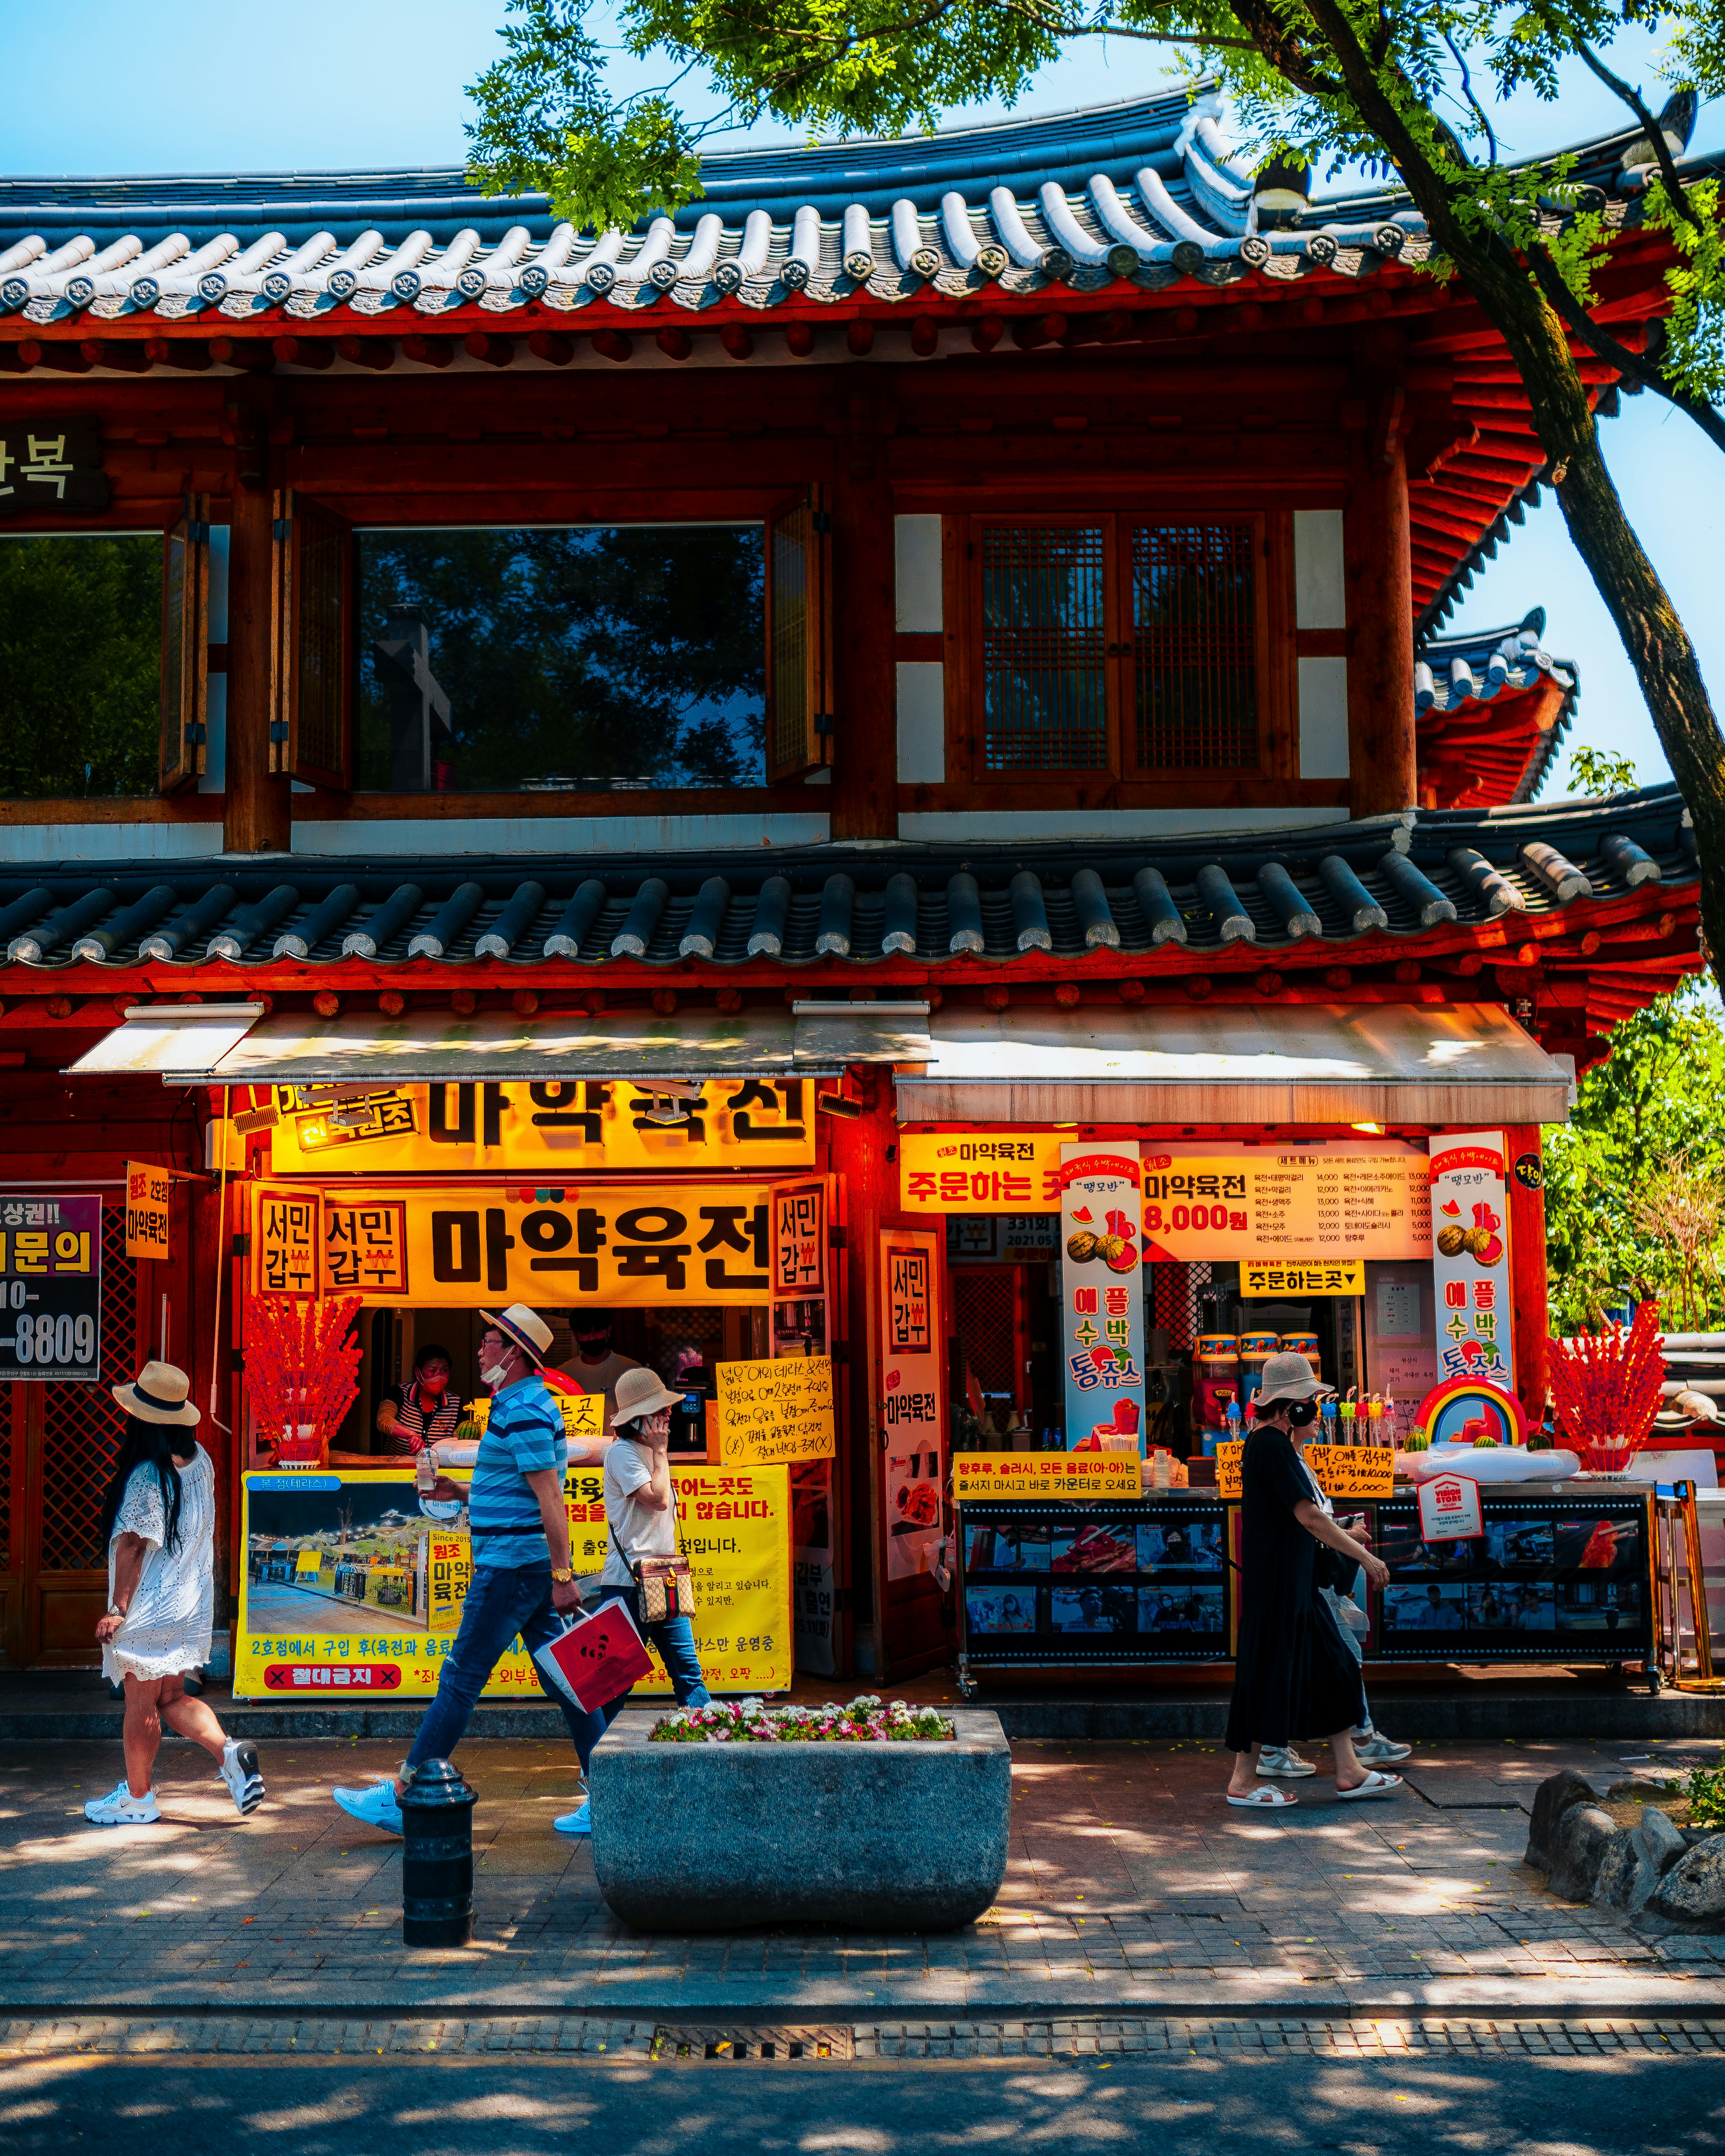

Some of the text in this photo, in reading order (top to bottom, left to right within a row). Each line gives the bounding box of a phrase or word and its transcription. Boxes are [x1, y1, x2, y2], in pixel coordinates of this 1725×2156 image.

[938, 1142, 1034, 1161] 원조 마약육전
[1065, 1159, 1135, 1175] 태국식 수박에이드
[1146, 1156, 1170, 1171] 원조
[130, 1173, 167, 1203] 원조 2호점
[908, 1171, 1031, 1202] 주문하는
[1145, 1175, 1246, 1199] 마약육전
[0, 1204, 59, 1225] 상권!!
[267, 1204, 310, 1244] 서민
[781, 1196, 816, 1238] 서민
[1145, 1205, 1247, 1234] 8,000원
[128, 1209, 167, 1244] 마약육전
[326, 1210, 392, 1245] 서민
[0, 1231, 90, 1272] 문의
[432, 1206, 769, 1292] 마약육전
[894, 1259, 924, 1298] 서민
[1249, 1270, 1342, 1290] 주문하는곳
[1075, 1287, 1129, 1315] 애플
[1446, 1281, 1495, 1308] 애플
[1075, 1319, 1129, 1346] 수박
[1447, 1313, 1496, 1342] 수박
[1069, 1352, 1142, 1390] 통쥬스
[887, 1392, 936, 1425] 마약육전
[959, 1463, 996, 1476] 탕후루,
[999, 1463, 1037, 1476] 슬러시,
[1040, 1463, 1063, 1474] 모든
[959, 1477, 1137, 1491] 줄서지 마시고 바로 카운터로 오세요
[1435, 1488, 1461, 1497] VISION
[1436, 1495, 1461, 1504] STORE
[565, 1504, 605, 1522] 점을
[695, 1500, 774, 1520] 않습니다.
[433, 1534, 453, 1542] Since
[679, 1538, 742, 1555] 전입니다.
[434, 1544, 461, 1560] 원조
[434, 1562, 470, 1581] 마약
[794, 1561, 823, 1587] 갑부
[434, 1581, 468, 1602] 육전
[707, 1582, 732, 1591] 알리고
[736, 1580, 772, 1591] 있습니다.
[706, 1596, 734, 1607] 있지만,
[252, 1639, 315, 1657] 2호점에서
[323, 1640, 349, 1657] 구입
[358, 1639, 418, 1657] 후(육전과
[695, 1636, 728, 1652] 라스만
[736, 1636, 774, 1652] 운영중
[292, 1668, 371, 1685] 절대금지
[500, 1668, 538, 1686] 외부음
[701, 1668, 725, 1682] 강정,
